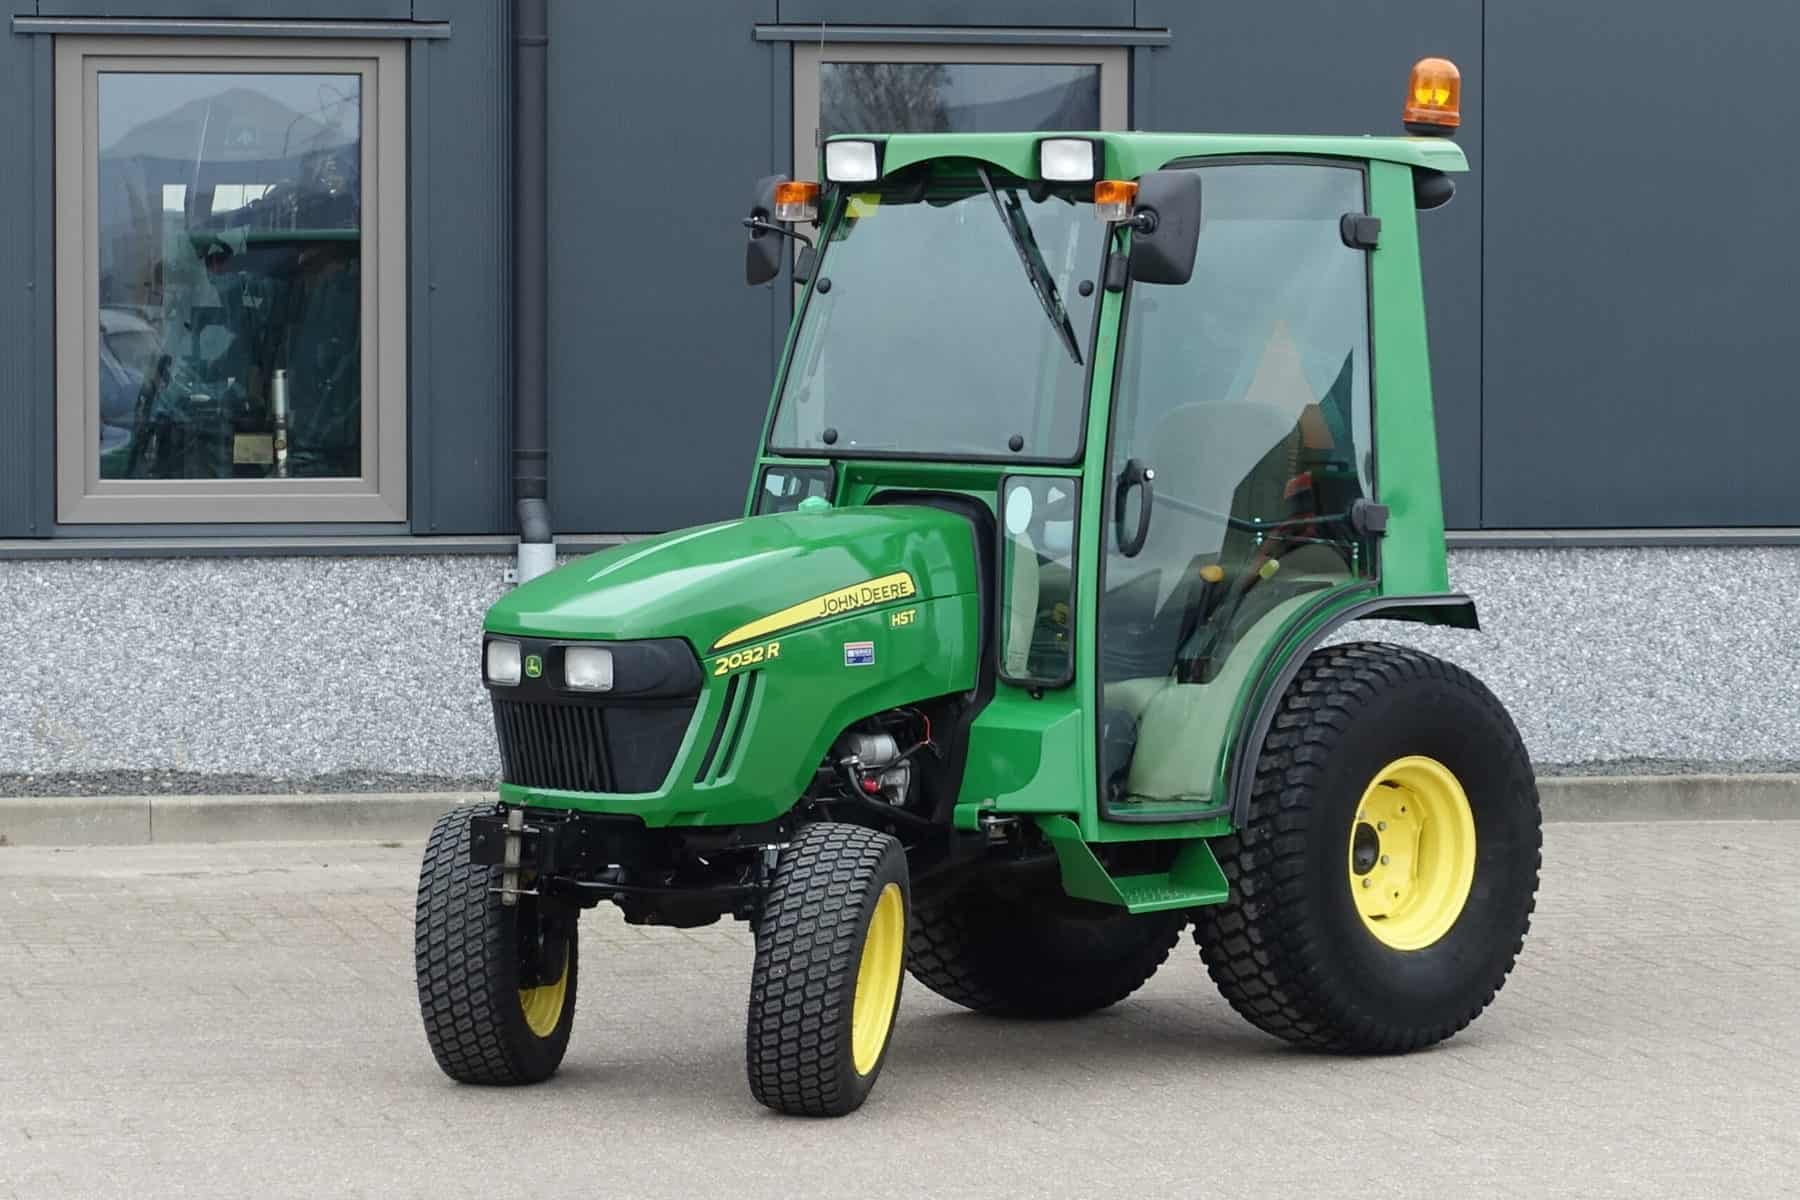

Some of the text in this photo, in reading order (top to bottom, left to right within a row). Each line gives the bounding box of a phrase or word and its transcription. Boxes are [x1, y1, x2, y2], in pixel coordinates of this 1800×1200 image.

[819, 581, 909, 615] JOHN DEERE
[891, 608, 916, 628] HST
[714, 642, 780, 676] 2032 R
